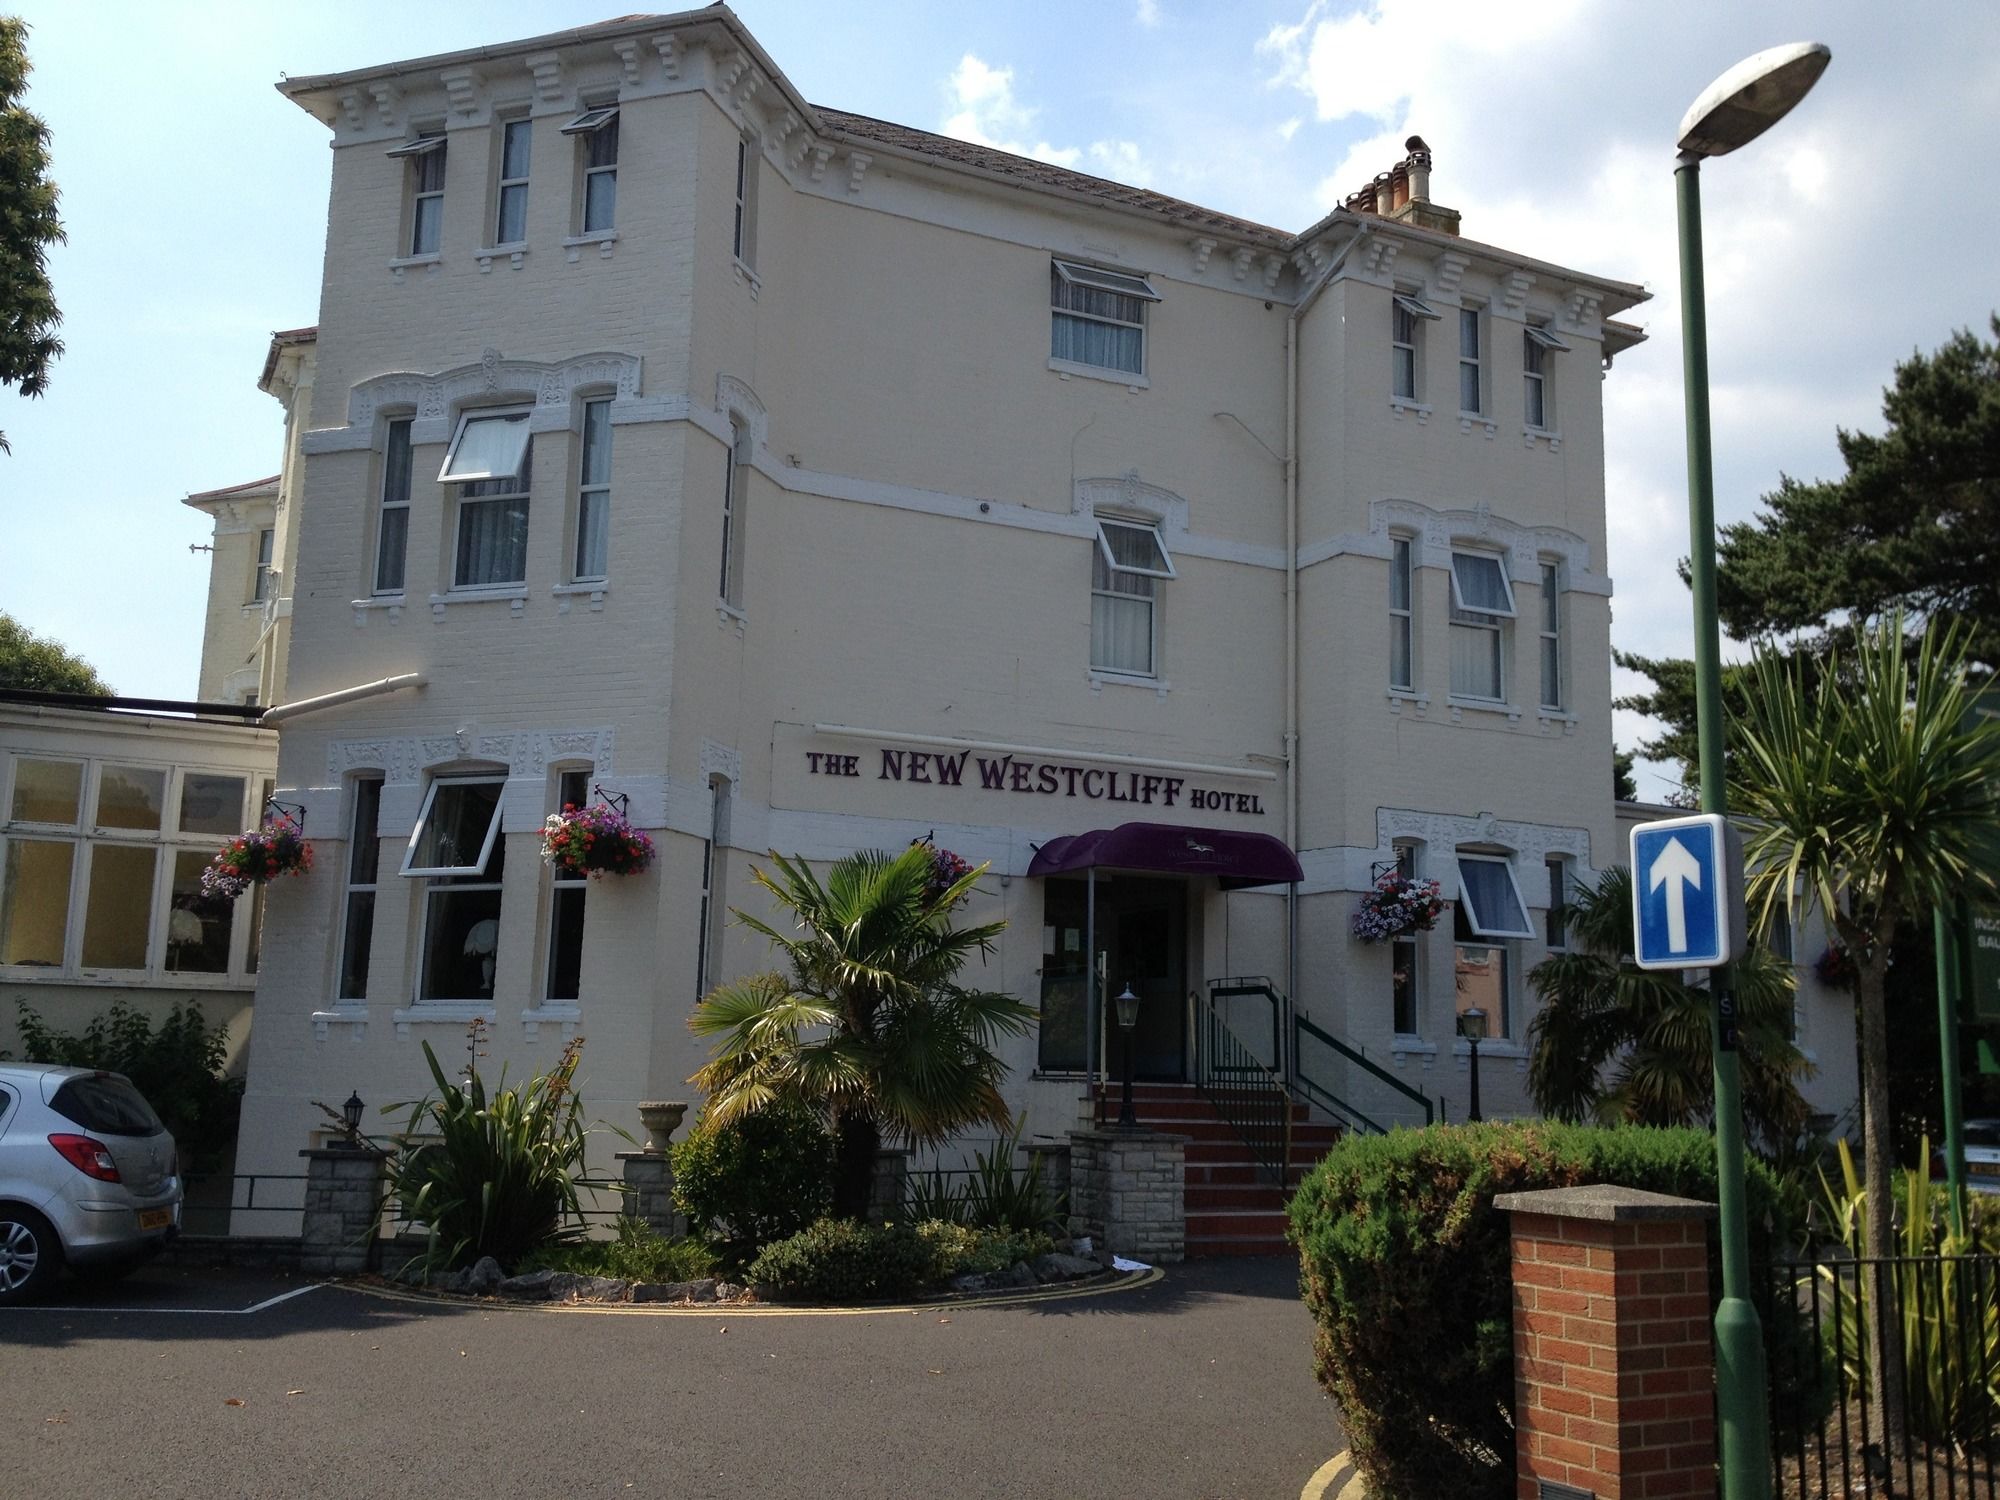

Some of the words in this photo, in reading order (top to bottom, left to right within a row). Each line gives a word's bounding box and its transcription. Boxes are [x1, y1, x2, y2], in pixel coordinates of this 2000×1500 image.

[805, 751, 861, 778] THE
[878, 748, 972, 787] NEW
[975, 753, 1185, 807] WESTCLIFF
[1189, 788, 1266, 816] HOTEL
